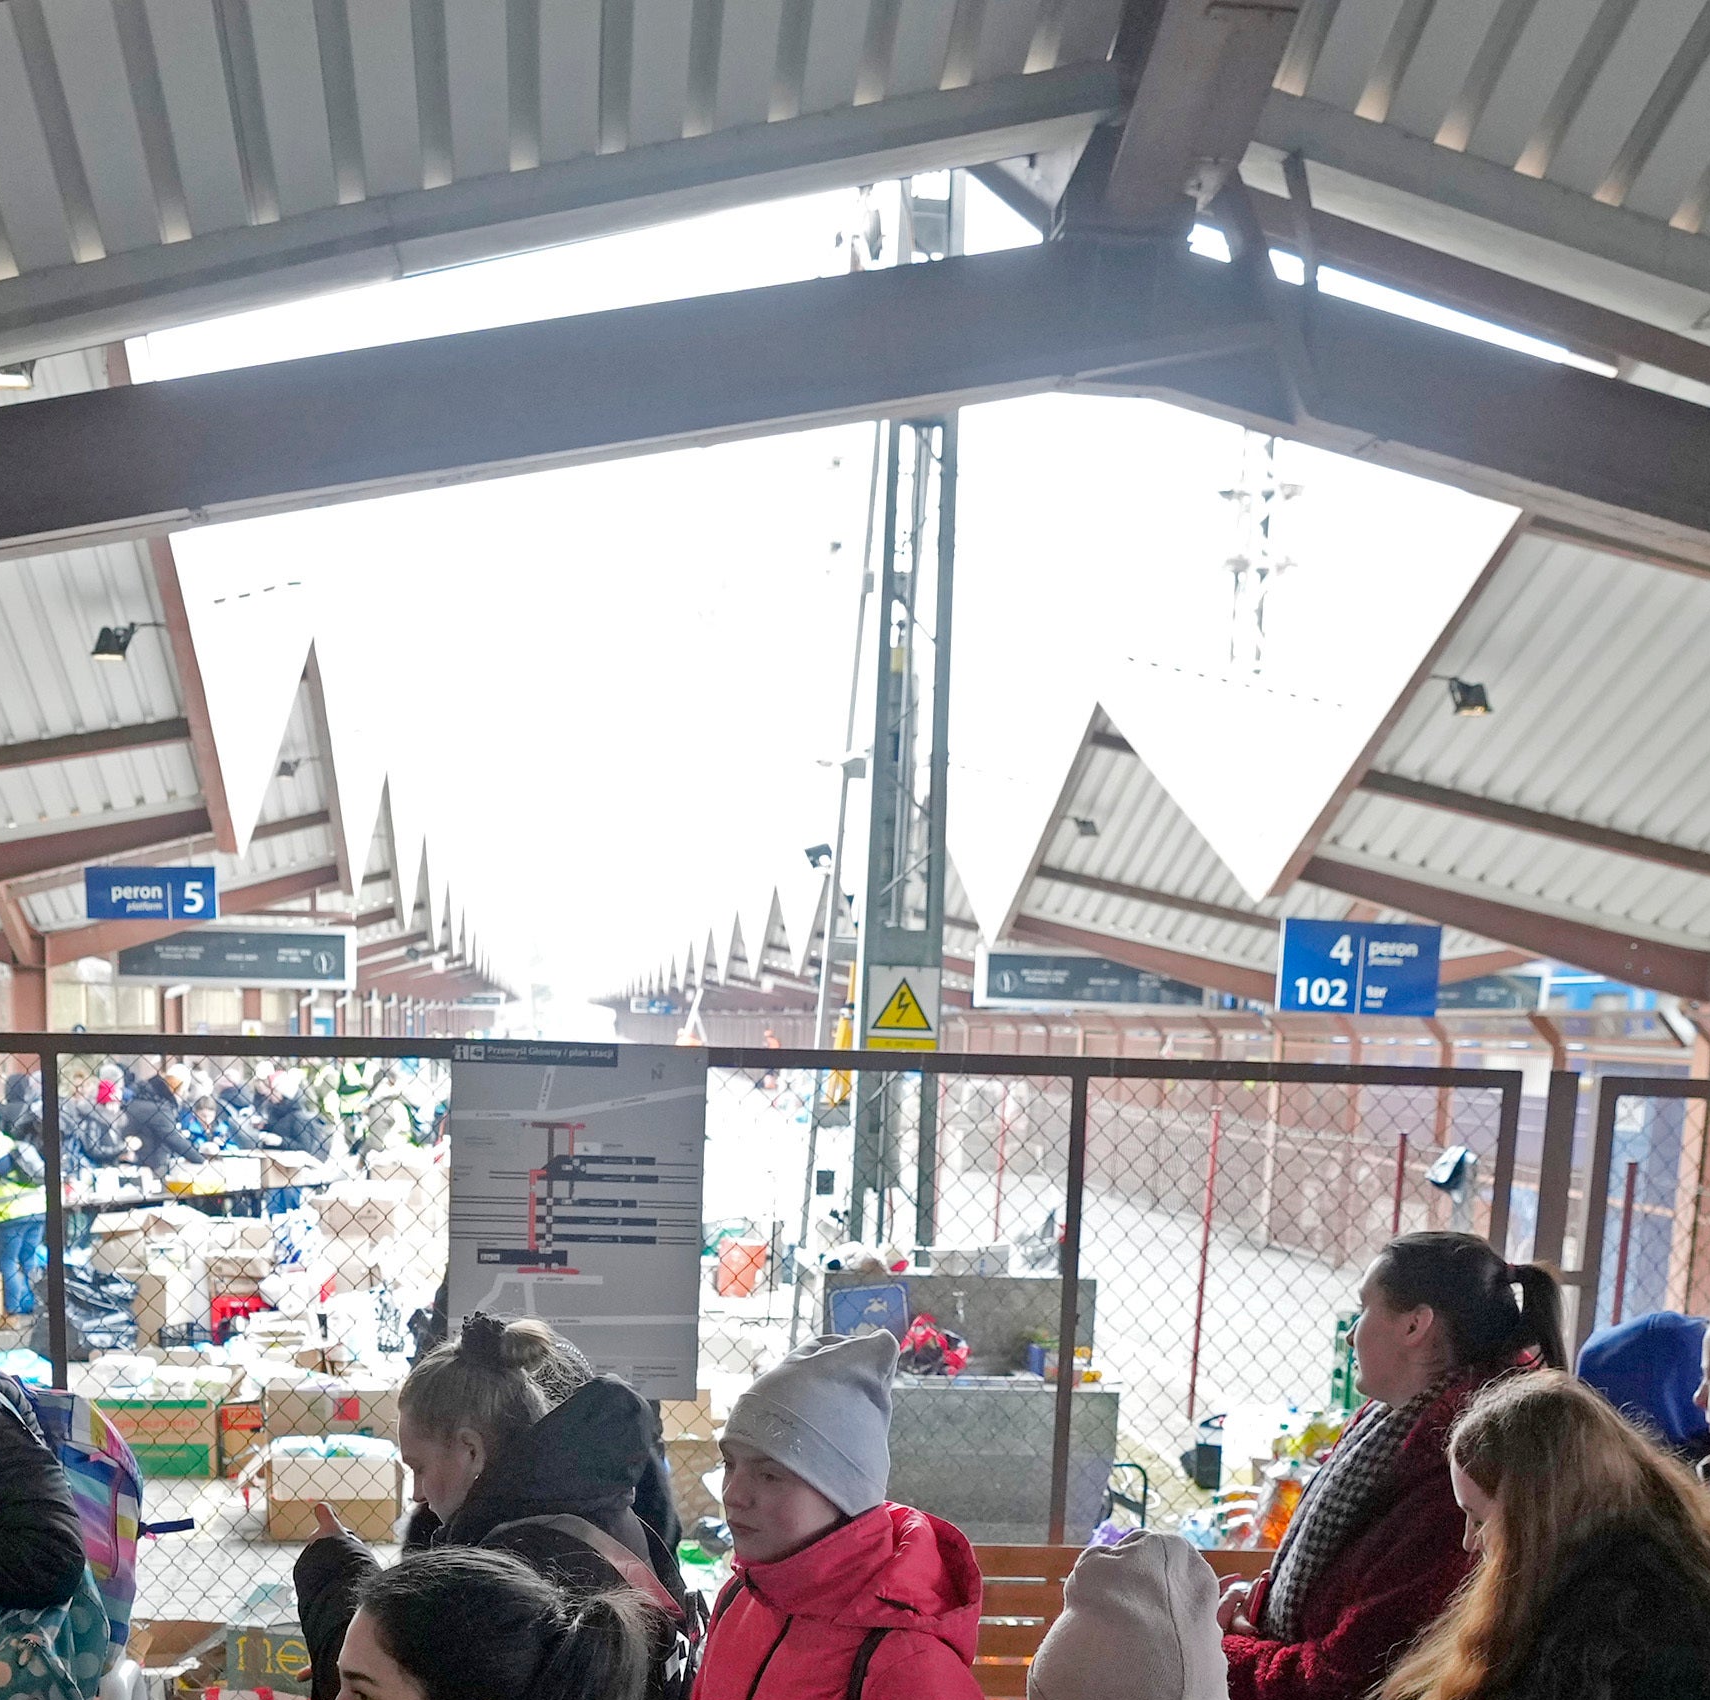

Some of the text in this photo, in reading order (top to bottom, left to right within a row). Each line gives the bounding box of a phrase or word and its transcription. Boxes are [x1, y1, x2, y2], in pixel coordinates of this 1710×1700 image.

[110, 881, 205, 914] peron 5
[1329, 934, 1419, 966] 4 peron
[1294, 976, 1348, 1007] 102
